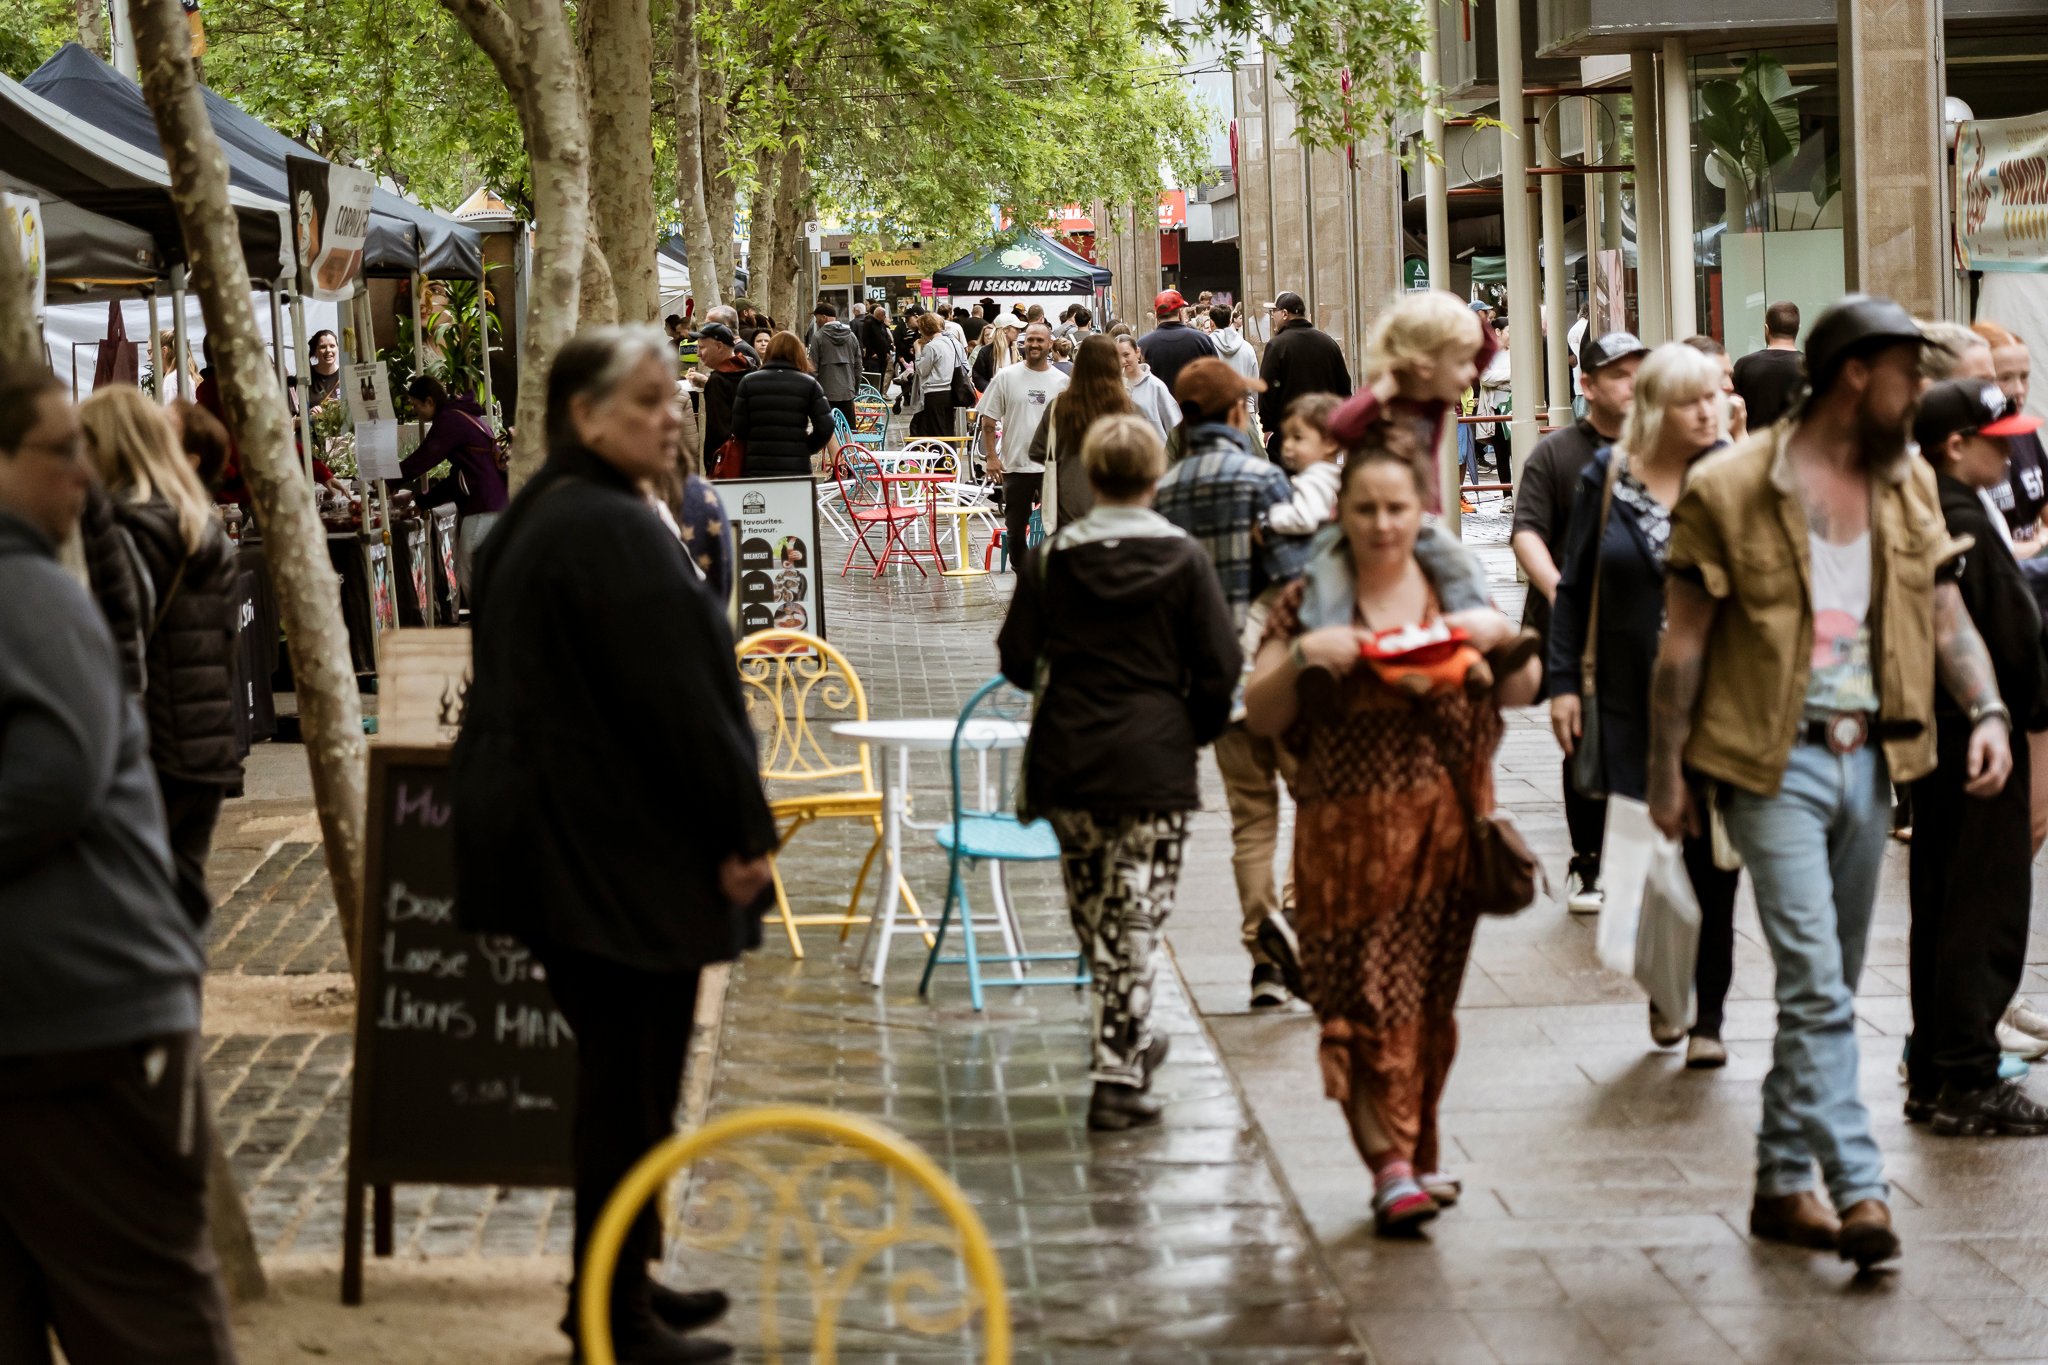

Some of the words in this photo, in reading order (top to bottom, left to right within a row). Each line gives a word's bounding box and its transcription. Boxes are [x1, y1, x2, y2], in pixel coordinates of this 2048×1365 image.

[967, 279, 983, 291] IN
[984, 280, 1031, 292] SEASON
[1030, 279, 1073, 292] JUICES
[743, 518, 784, 526] favourites.
[743, 552, 769, 560] BREAKFAST
[749, 583, 765, 591] LUNCH
[752, 617, 768, 625] DINNER
